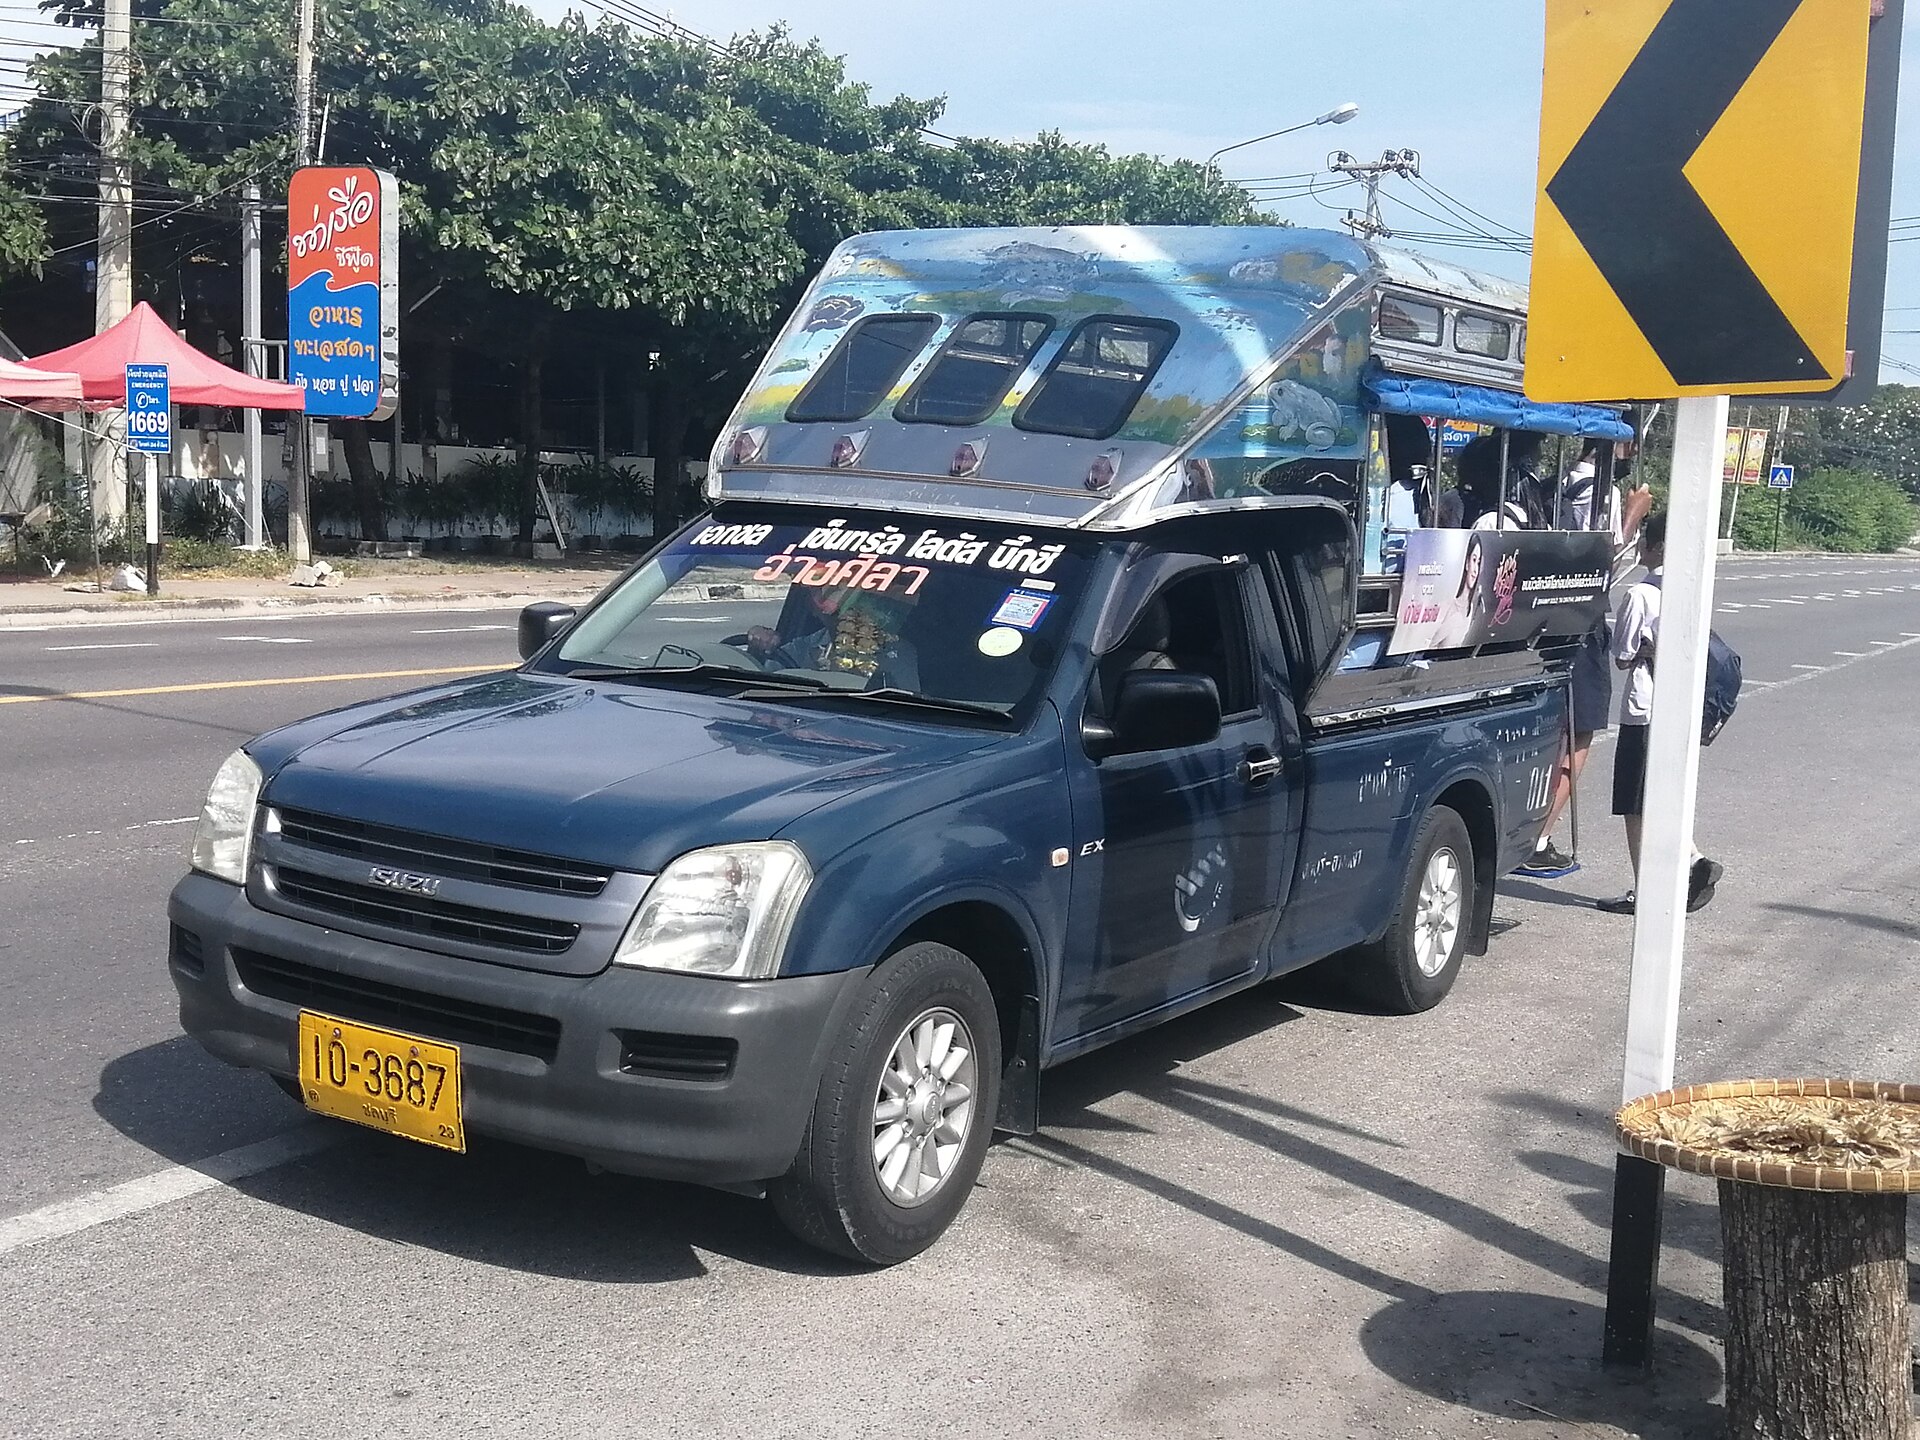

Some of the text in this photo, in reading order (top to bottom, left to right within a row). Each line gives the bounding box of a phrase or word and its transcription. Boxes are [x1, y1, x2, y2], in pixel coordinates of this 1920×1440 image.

[309, 306, 363, 328] อาหาร
[312, 378, 336, 395] หอย
[339, 374, 349, 397] ปู
[352, 374, 374, 397] ปลา
[128, 411, 168, 433] 1669
[798, 519, 906, 555] เซ็นทรัล
[906, 529, 989, 565] โลตัส
[988, 535, 1066, 575] บิ๊กซี
[753, 543, 930, 596] อ่างศิลา
[1080, 838, 1105, 856] EX
[368, 867, 440, 896] ISUZU
[314, 1033, 447, 1112] 10-3687
[362, 1102, 398, 1125] ชลบุรี
[438, 1124, 455, 1139] 23
